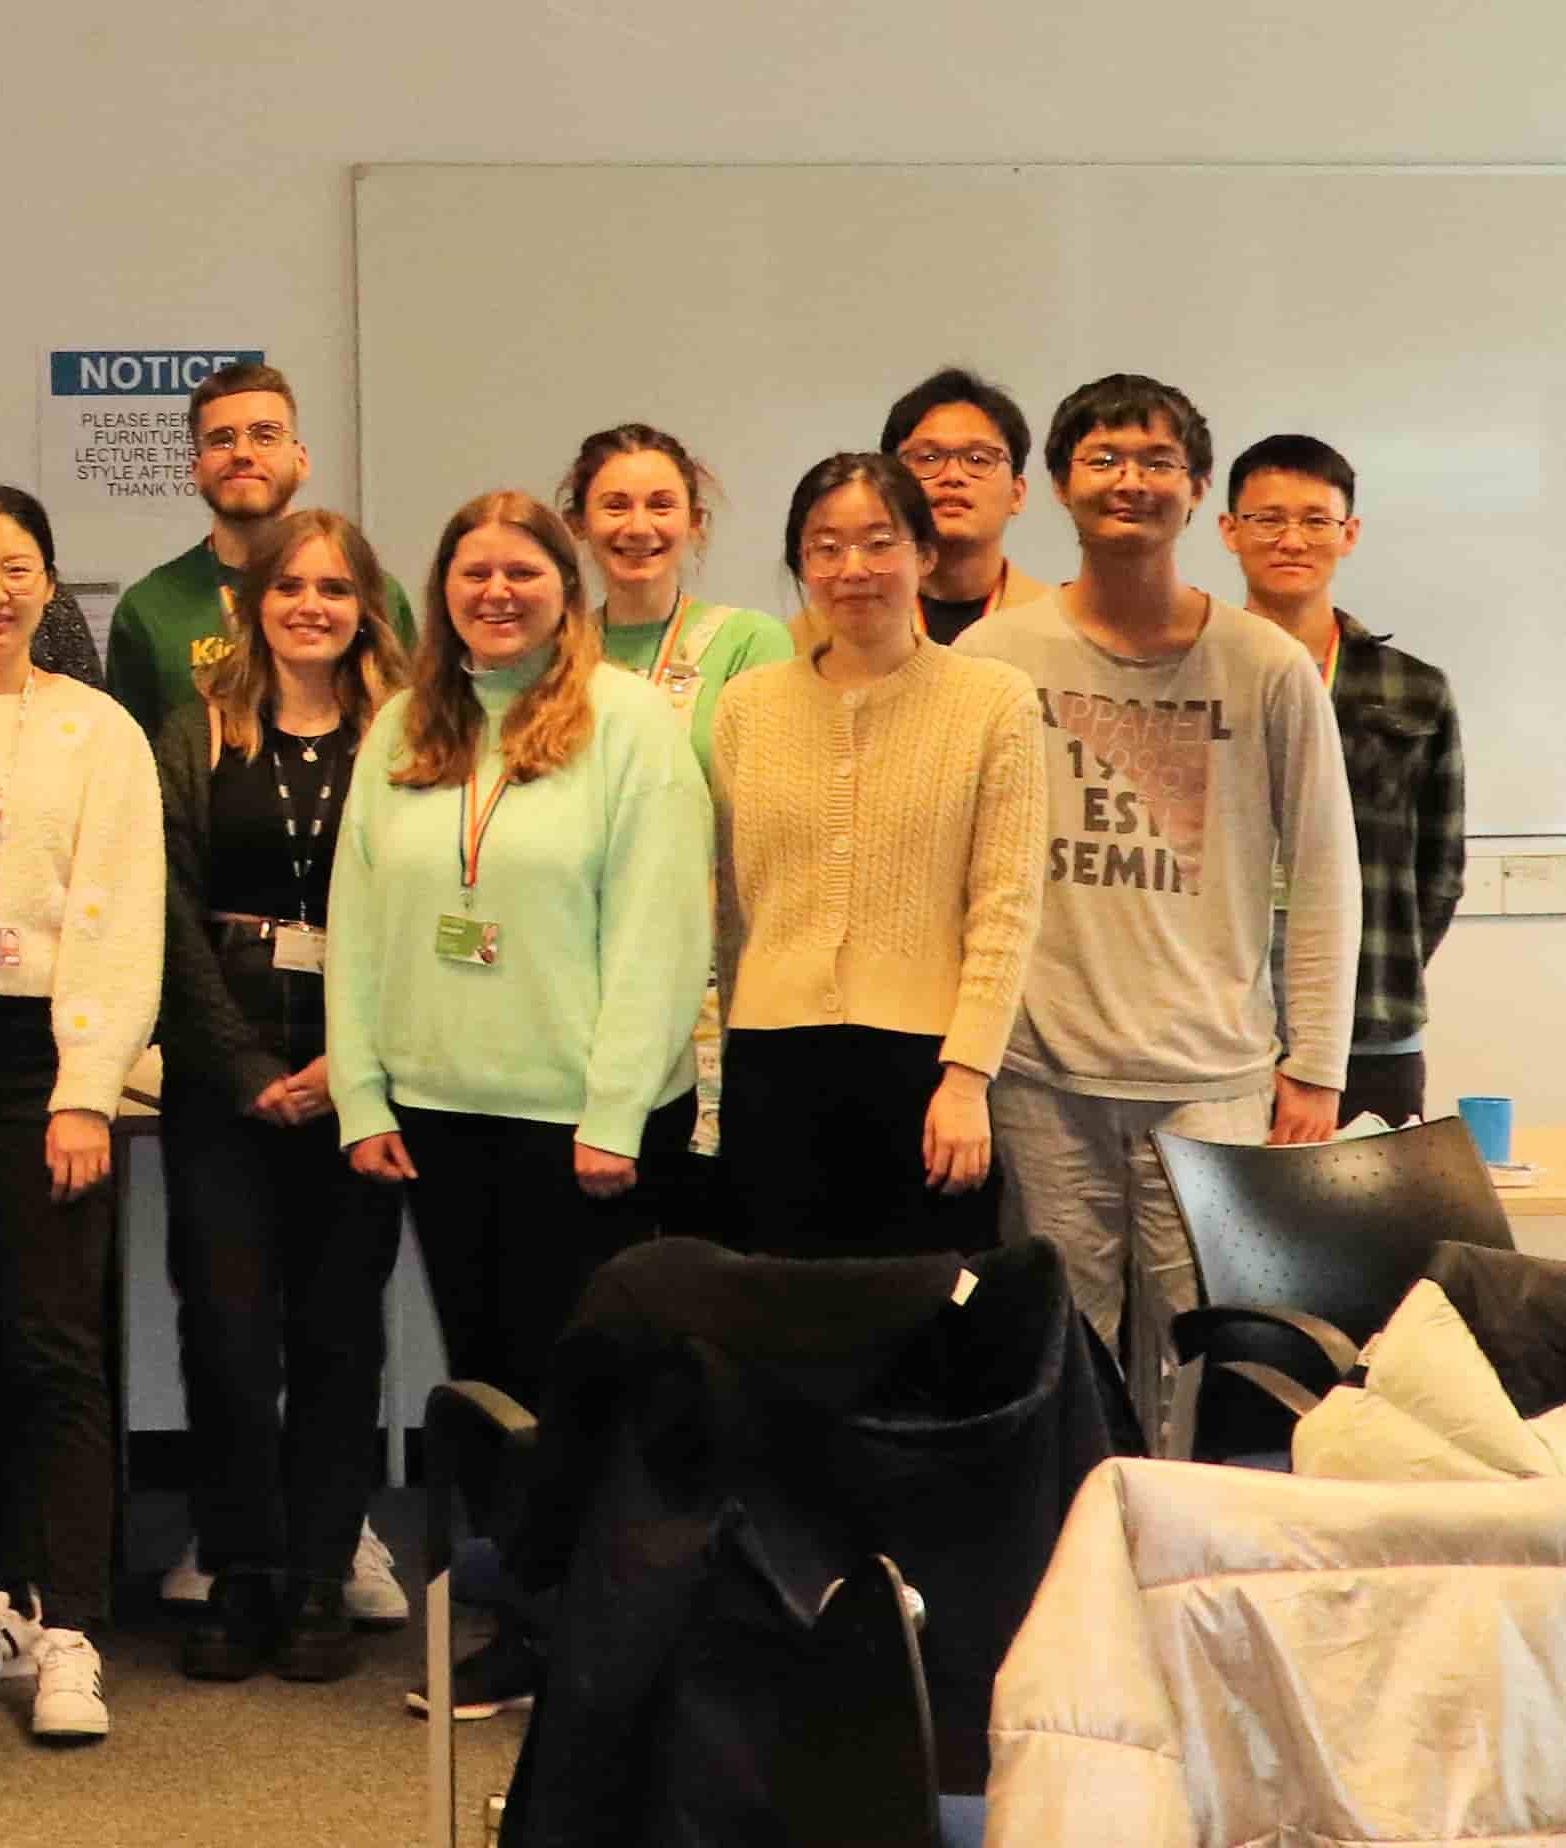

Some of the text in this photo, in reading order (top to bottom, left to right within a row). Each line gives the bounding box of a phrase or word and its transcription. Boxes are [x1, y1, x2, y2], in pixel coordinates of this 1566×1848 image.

[82, 413, 148, 427] PLEASE
[94, 431, 195, 445] FURNITURE
[75, 448, 195, 463] LECTURE THE
[77, 466, 133, 480] STYLE
[107, 483, 196, 497] THANK YO
